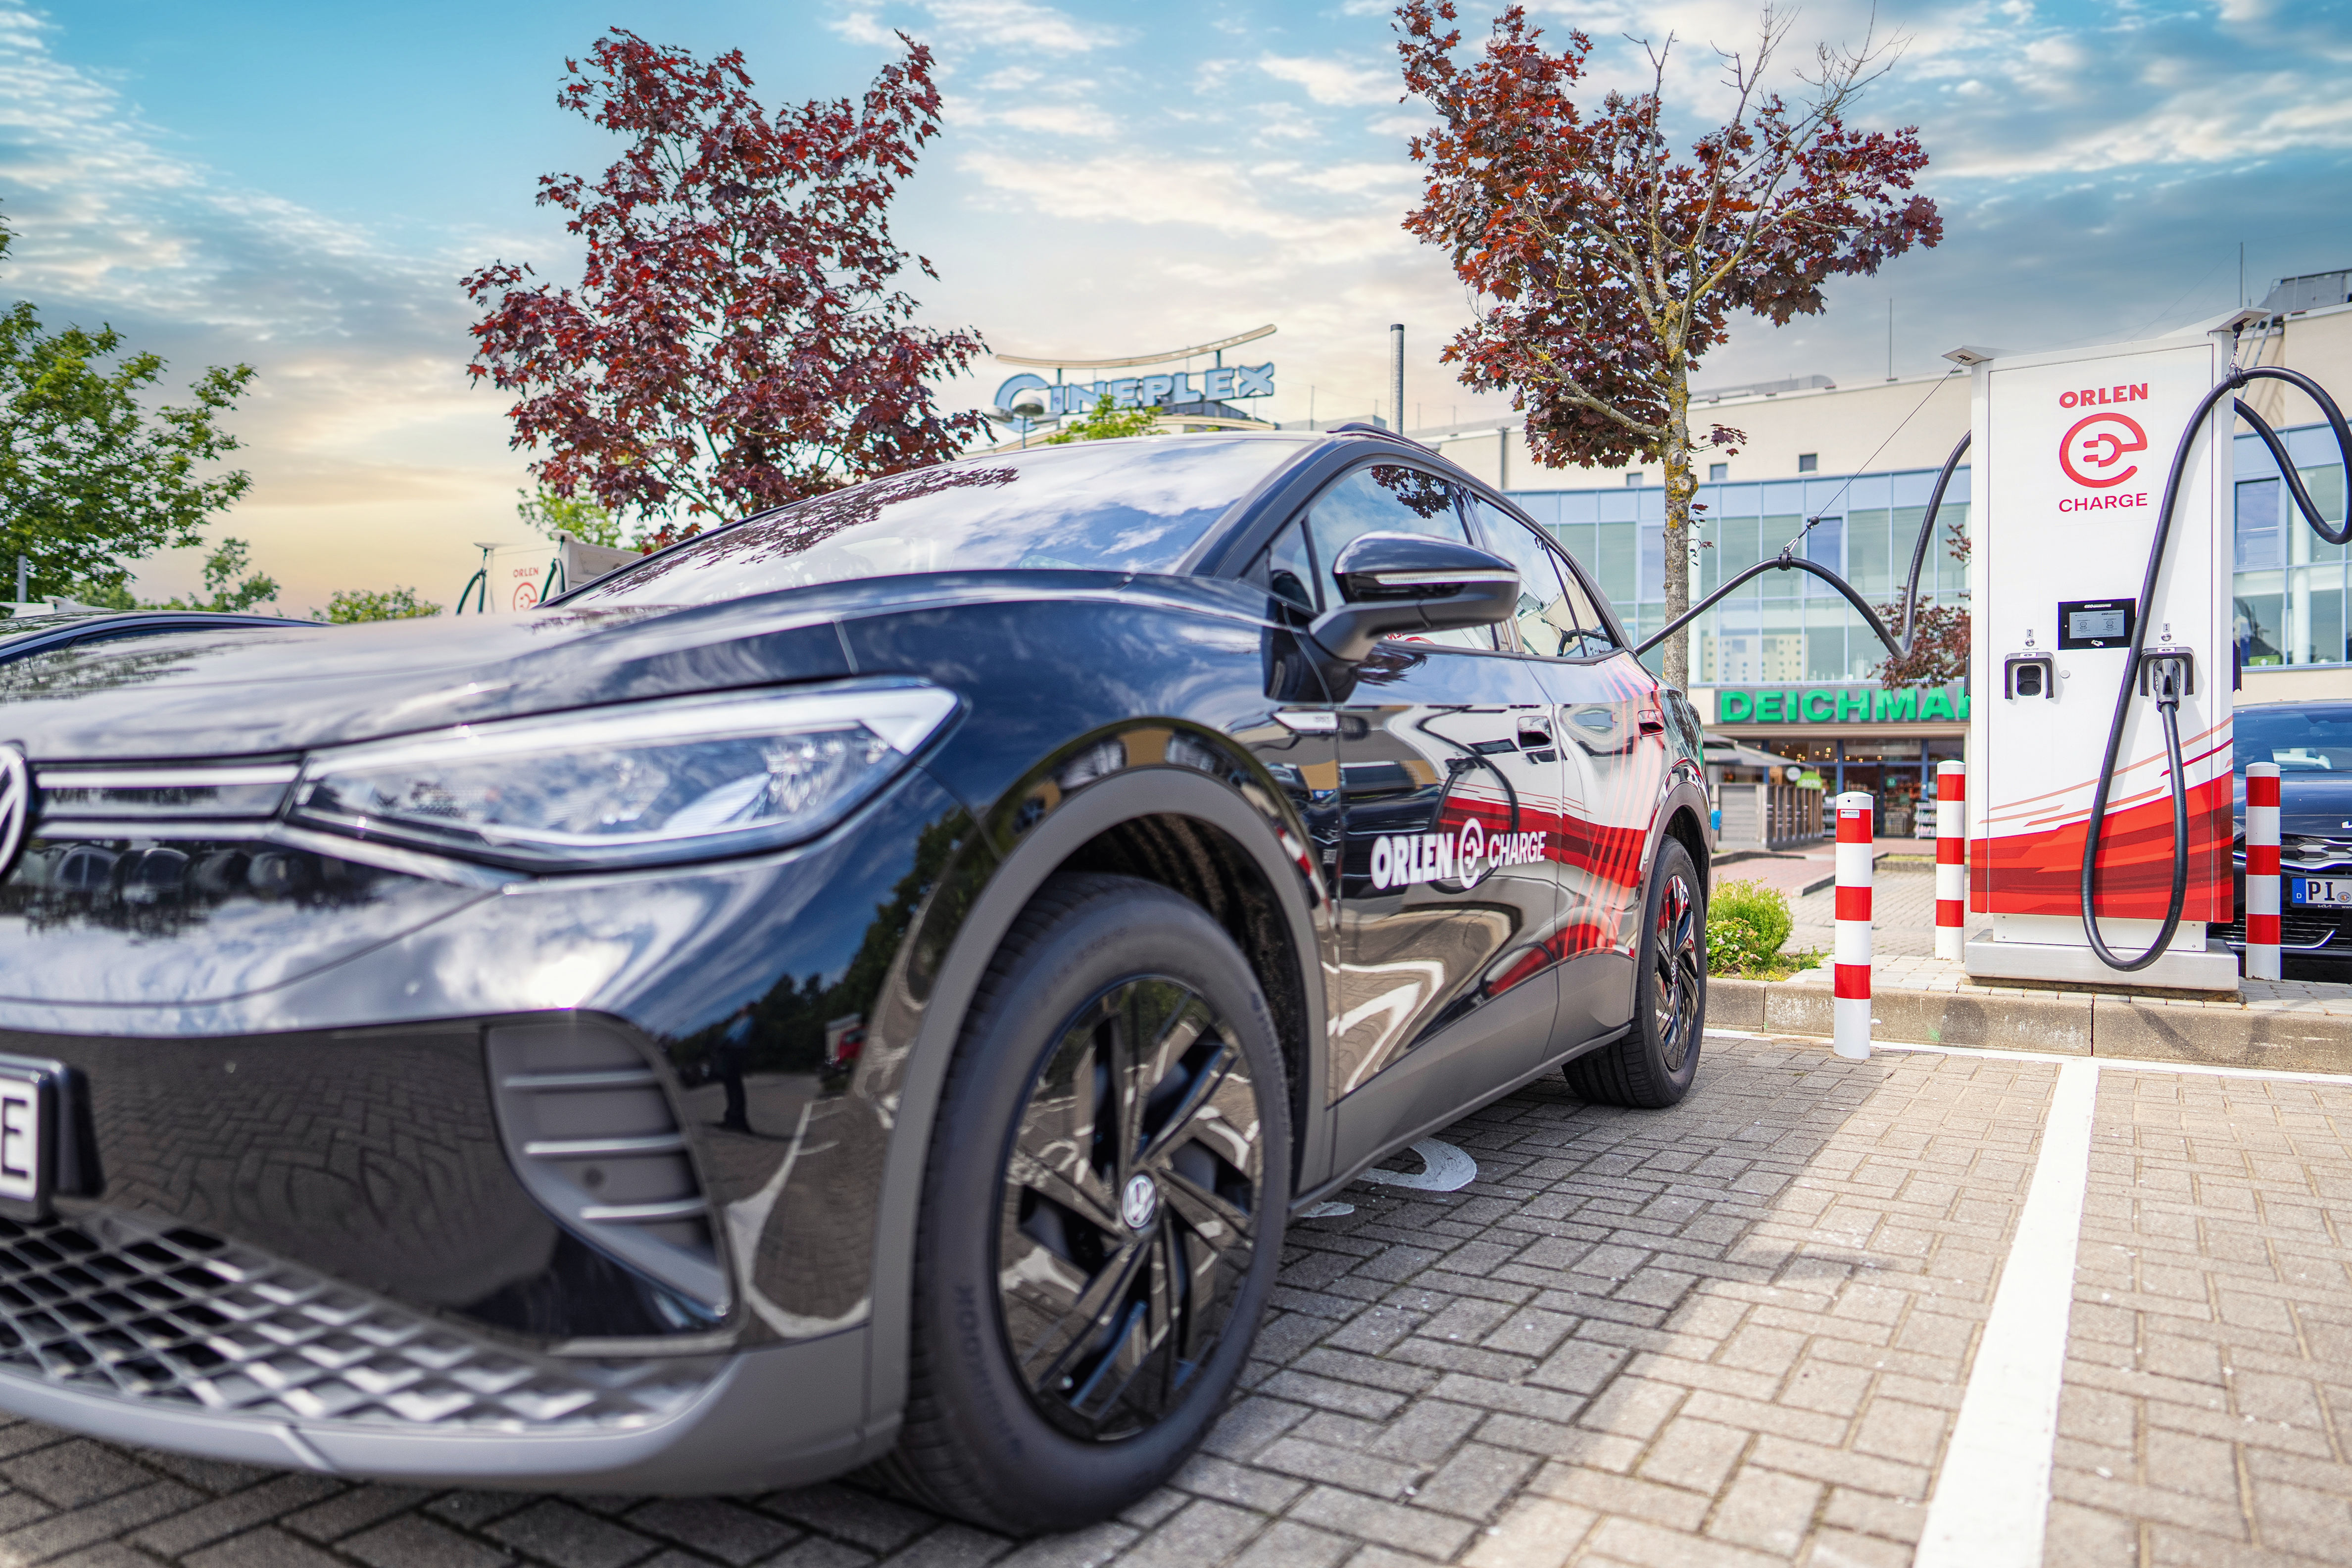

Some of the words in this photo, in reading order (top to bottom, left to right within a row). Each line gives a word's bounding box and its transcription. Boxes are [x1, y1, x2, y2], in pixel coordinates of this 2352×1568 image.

[995, 361, 1274, 433] CINEPLEX
[2059, 383, 2148, 408] ORLEN
[2059, 493, 2148, 512] CHARGE
[513, 567, 539, 578] ORLEN
[1371, 832, 1454, 889] ORLEN
[1487, 831, 1547, 869] CHARGE
[2307, 882, 2335, 901] PI
